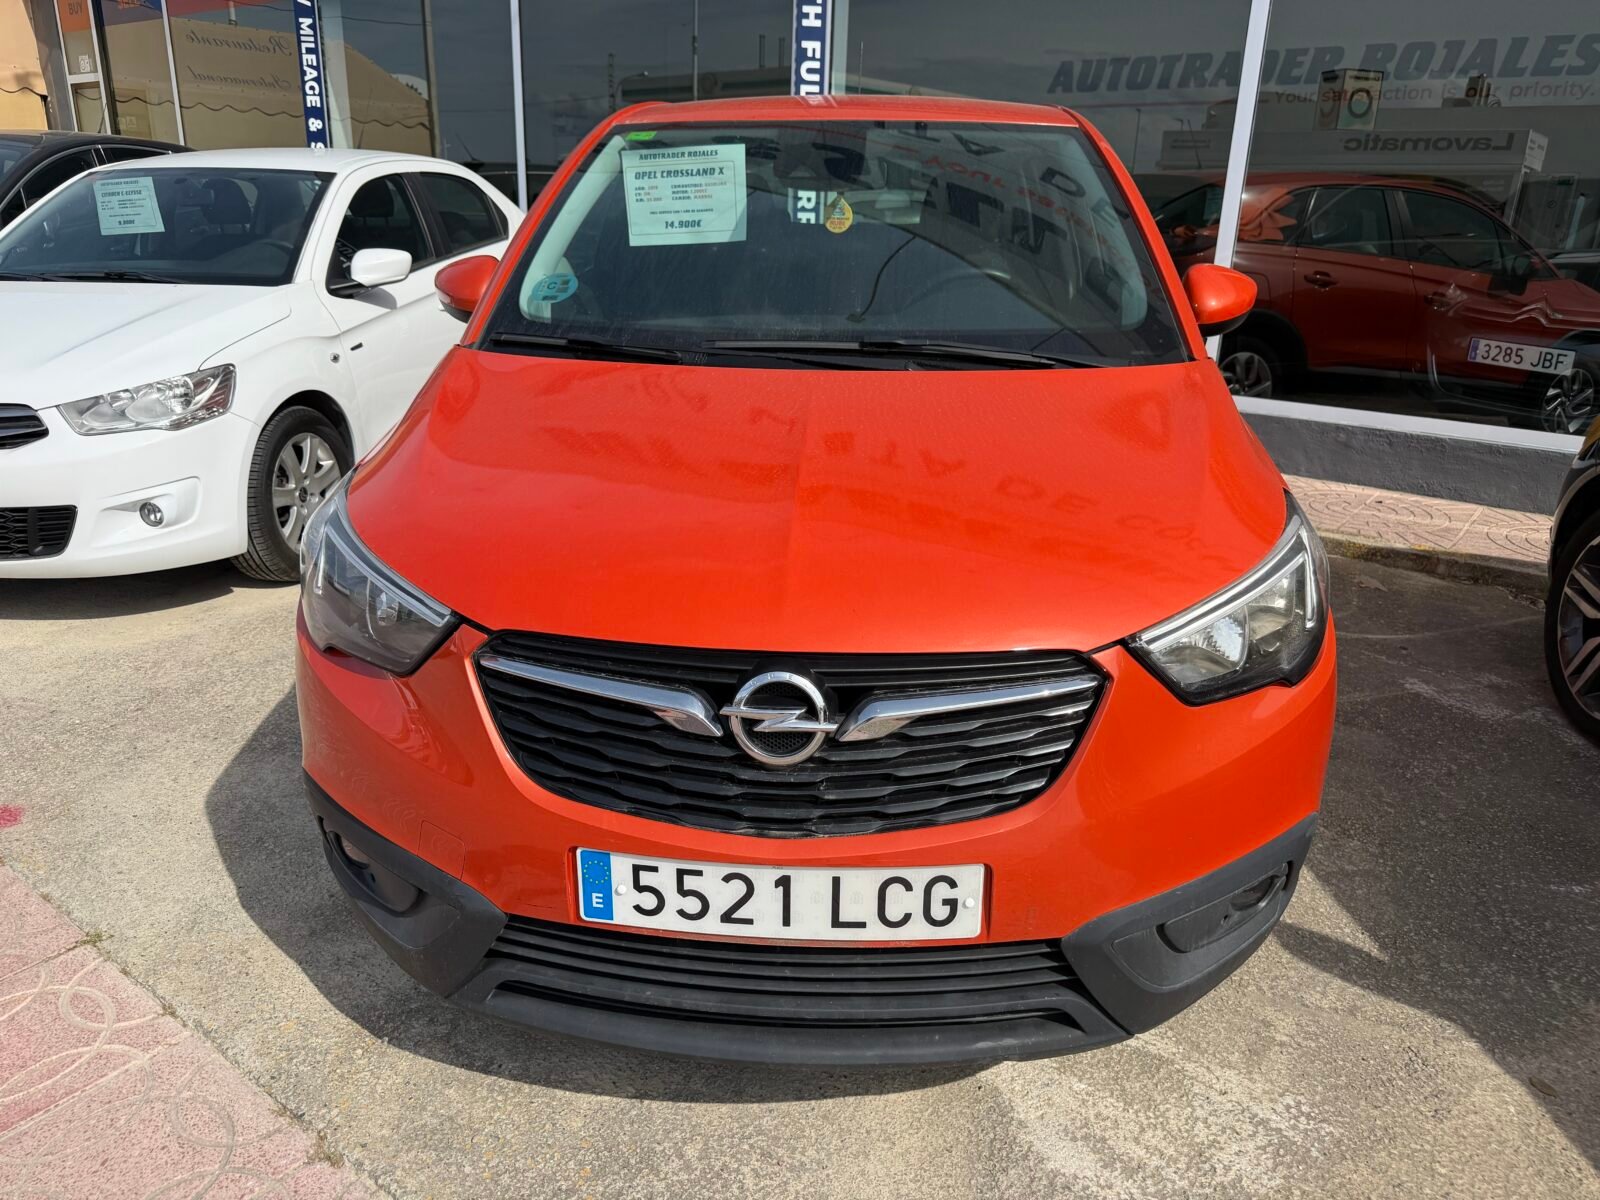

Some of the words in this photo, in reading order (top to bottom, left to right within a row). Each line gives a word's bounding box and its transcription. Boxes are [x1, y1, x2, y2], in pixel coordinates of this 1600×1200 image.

[68, 3, 83, 15] BUY
[802, 0, 822, 28] H
[299, 17, 321, 108] MILEAGE
[1047, 45, 1345, 94] AUTOTRADER
[1357, 33, 1600, 81] ROJALES
[1276, 90, 1317, 104] Your
[1322, 84, 1432, 103] satction
[1442, 82, 1457, 98] is
[1508, 79, 1595, 104] priority.
[308, 118, 323, 132] &
[639, 151, 686, 161] AUTOTRADER
[687, 149, 719, 158] ROJALES
[634, 170, 658, 180] OPEL
[660, 167, 716, 179] CROSSLAND
[717, 166, 725, 176] X
[664, 219, 703, 229] 14.900€
[1481, 344, 1524, 365] 3285
[1530, 352, 1568, 371] JBF
[592, 892, 603, 908] E
[631, 863, 791, 927] 5521
[831, 874, 959, 929] LCG
